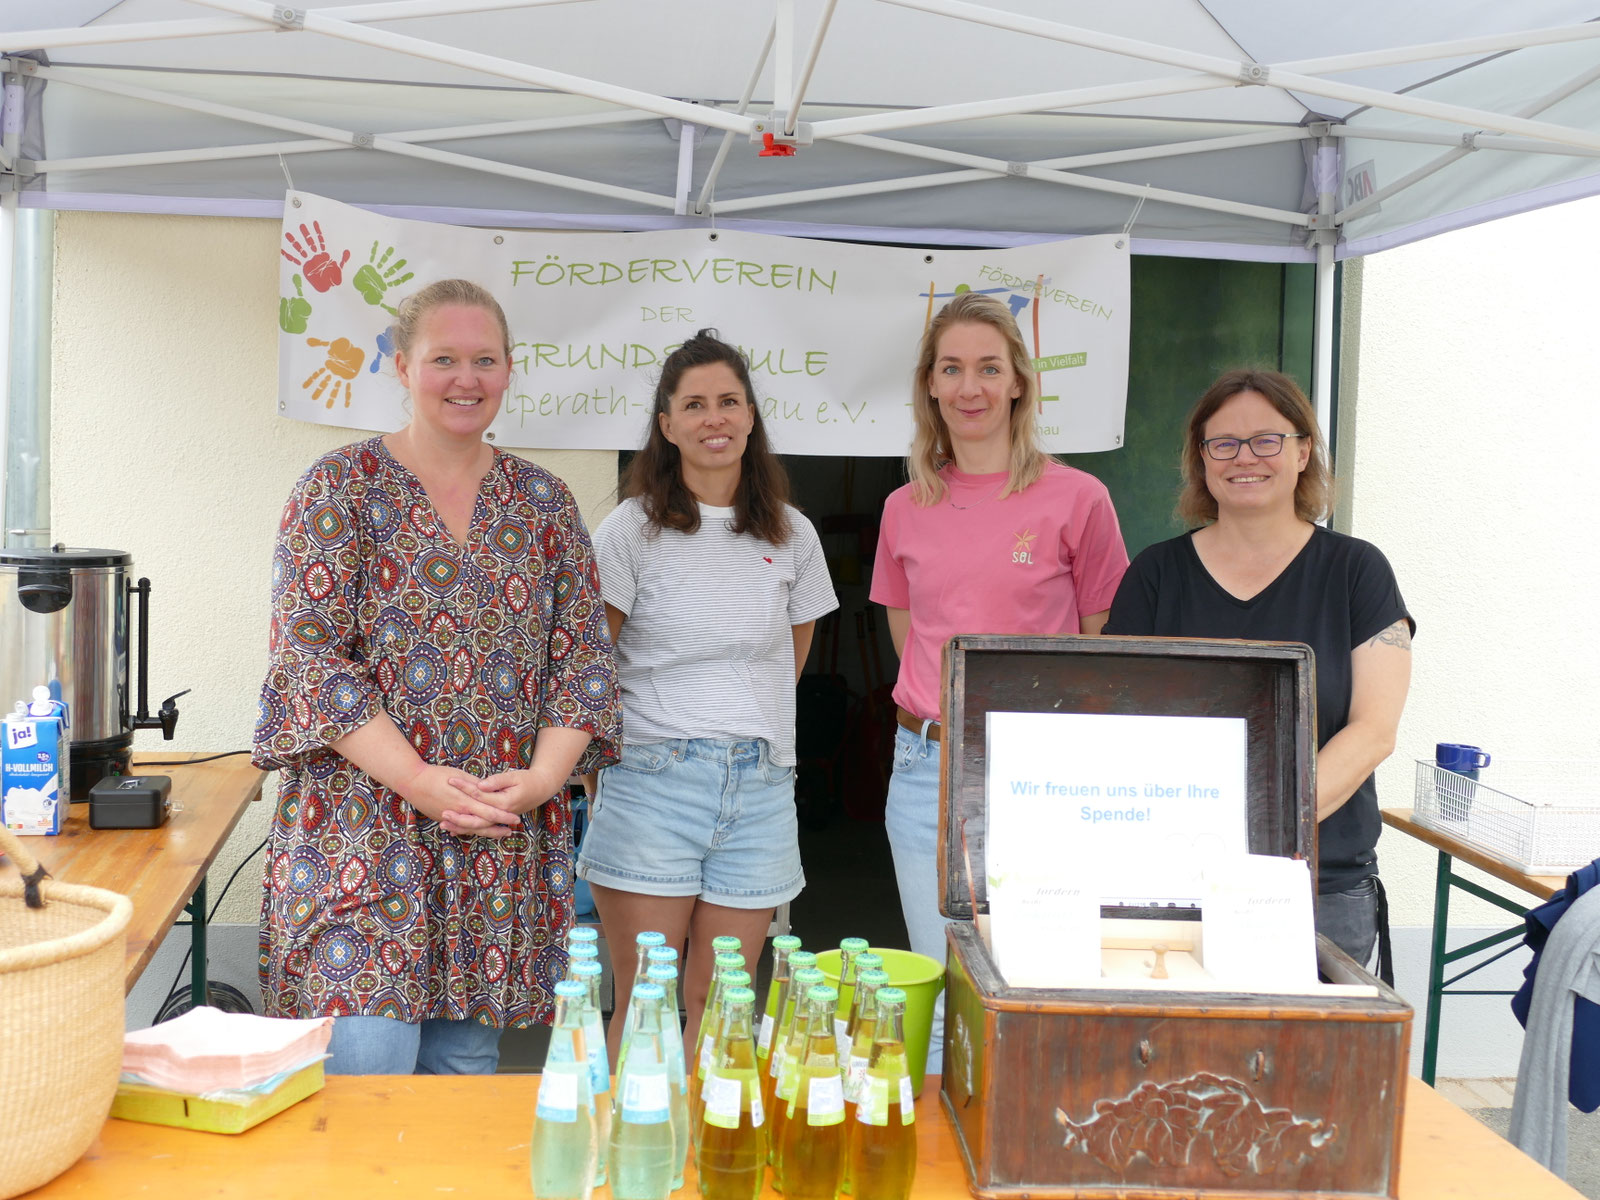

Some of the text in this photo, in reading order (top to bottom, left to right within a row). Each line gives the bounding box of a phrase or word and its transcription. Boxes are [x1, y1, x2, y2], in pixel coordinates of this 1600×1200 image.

[511, 255, 838, 296] FÖRDERVEREIN
[978, 264, 1114, 321] FÖRDERVEREIN
[640, 306, 696, 323] DER
[1038, 359, 1048, 369] in
[1049, 355, 1084, 368] Vielfalt
[816, 401, 877, 425] e.V.
[12, 727, 32, 744] ja!
[5, 763, 54, 772] H-VOLLMILCH
[1010, 781, 1220, 799] Wir freuen uns über Ihre
[1080, 806, 1151, 823] Spende!
